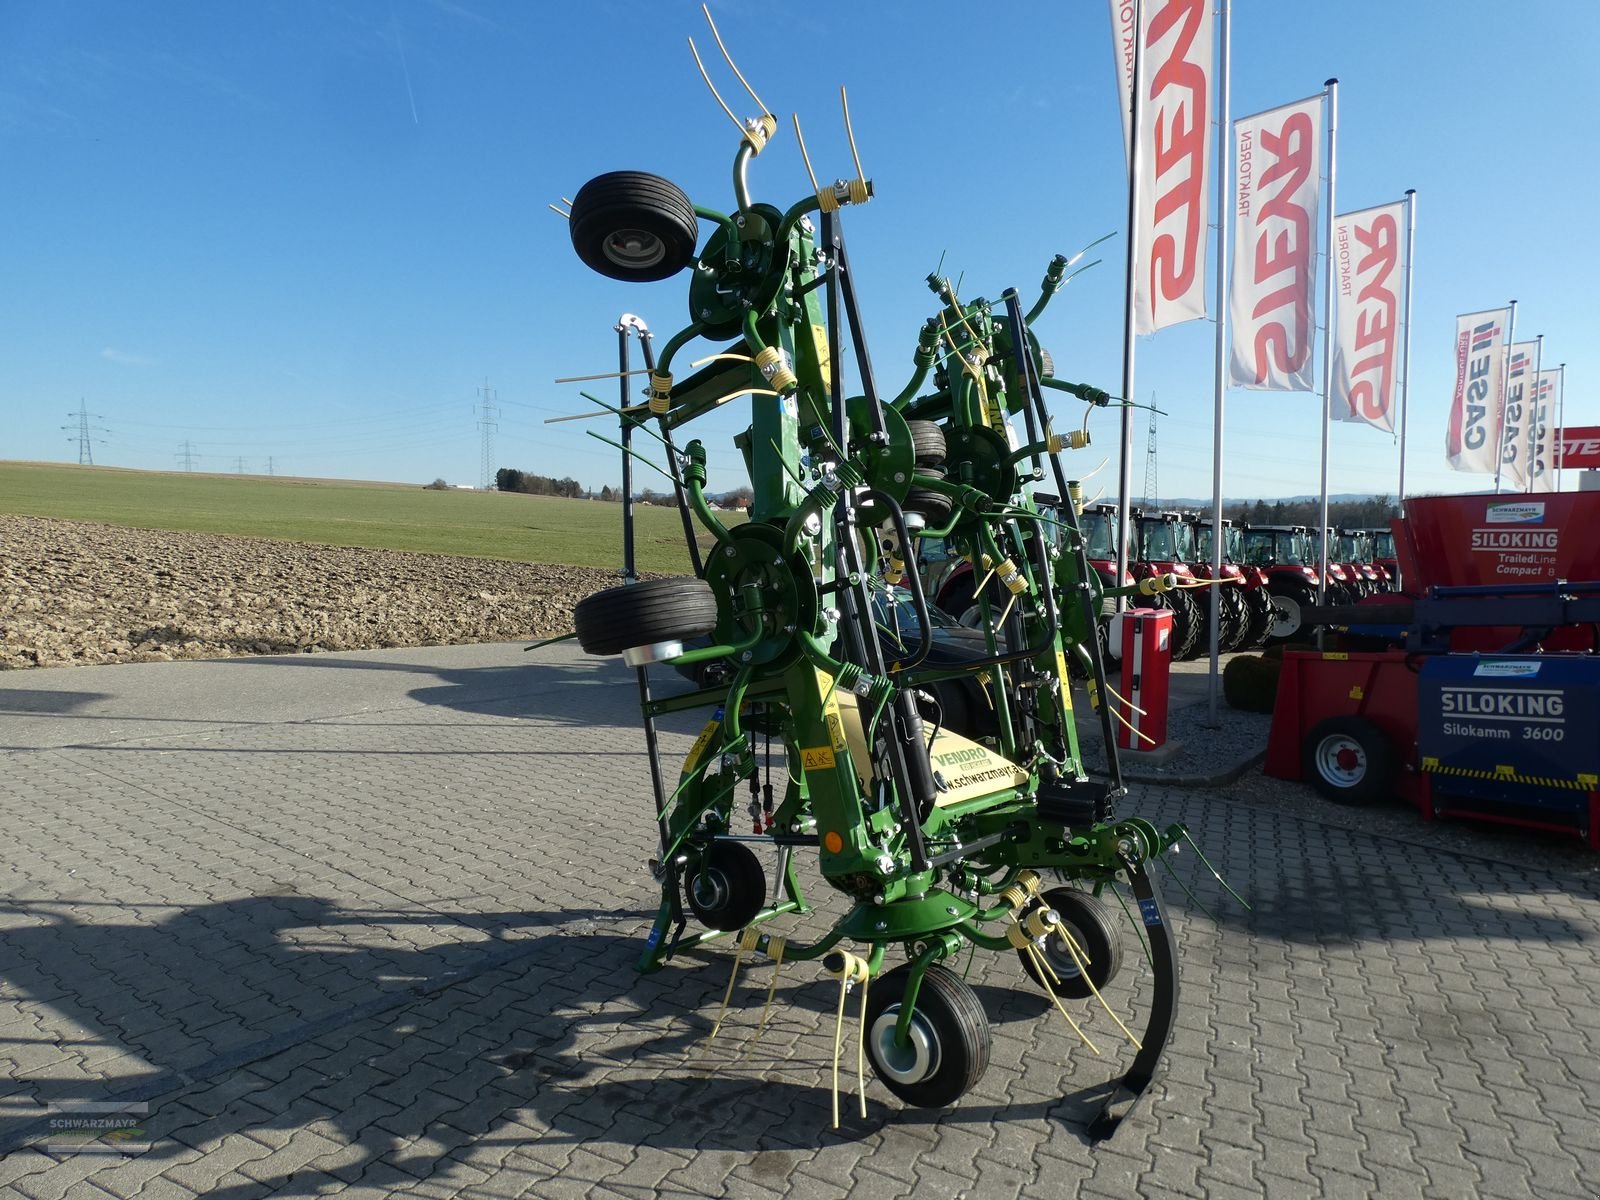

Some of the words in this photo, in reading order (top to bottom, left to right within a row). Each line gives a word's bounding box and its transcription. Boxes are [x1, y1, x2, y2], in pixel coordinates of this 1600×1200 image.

[1471, 532, 1558, 548] SILOKING
[1498, 553, 1557, 565] TrailedLine
[1496, 564, 1542, 577] Compact
[1441, 692, 1564, 716] SILOKING
[1443, 722, 1511, 739] Silokamm
[1522, 726, 1564, 742] 3600
[934, 746, 988, 768] VENDRO
